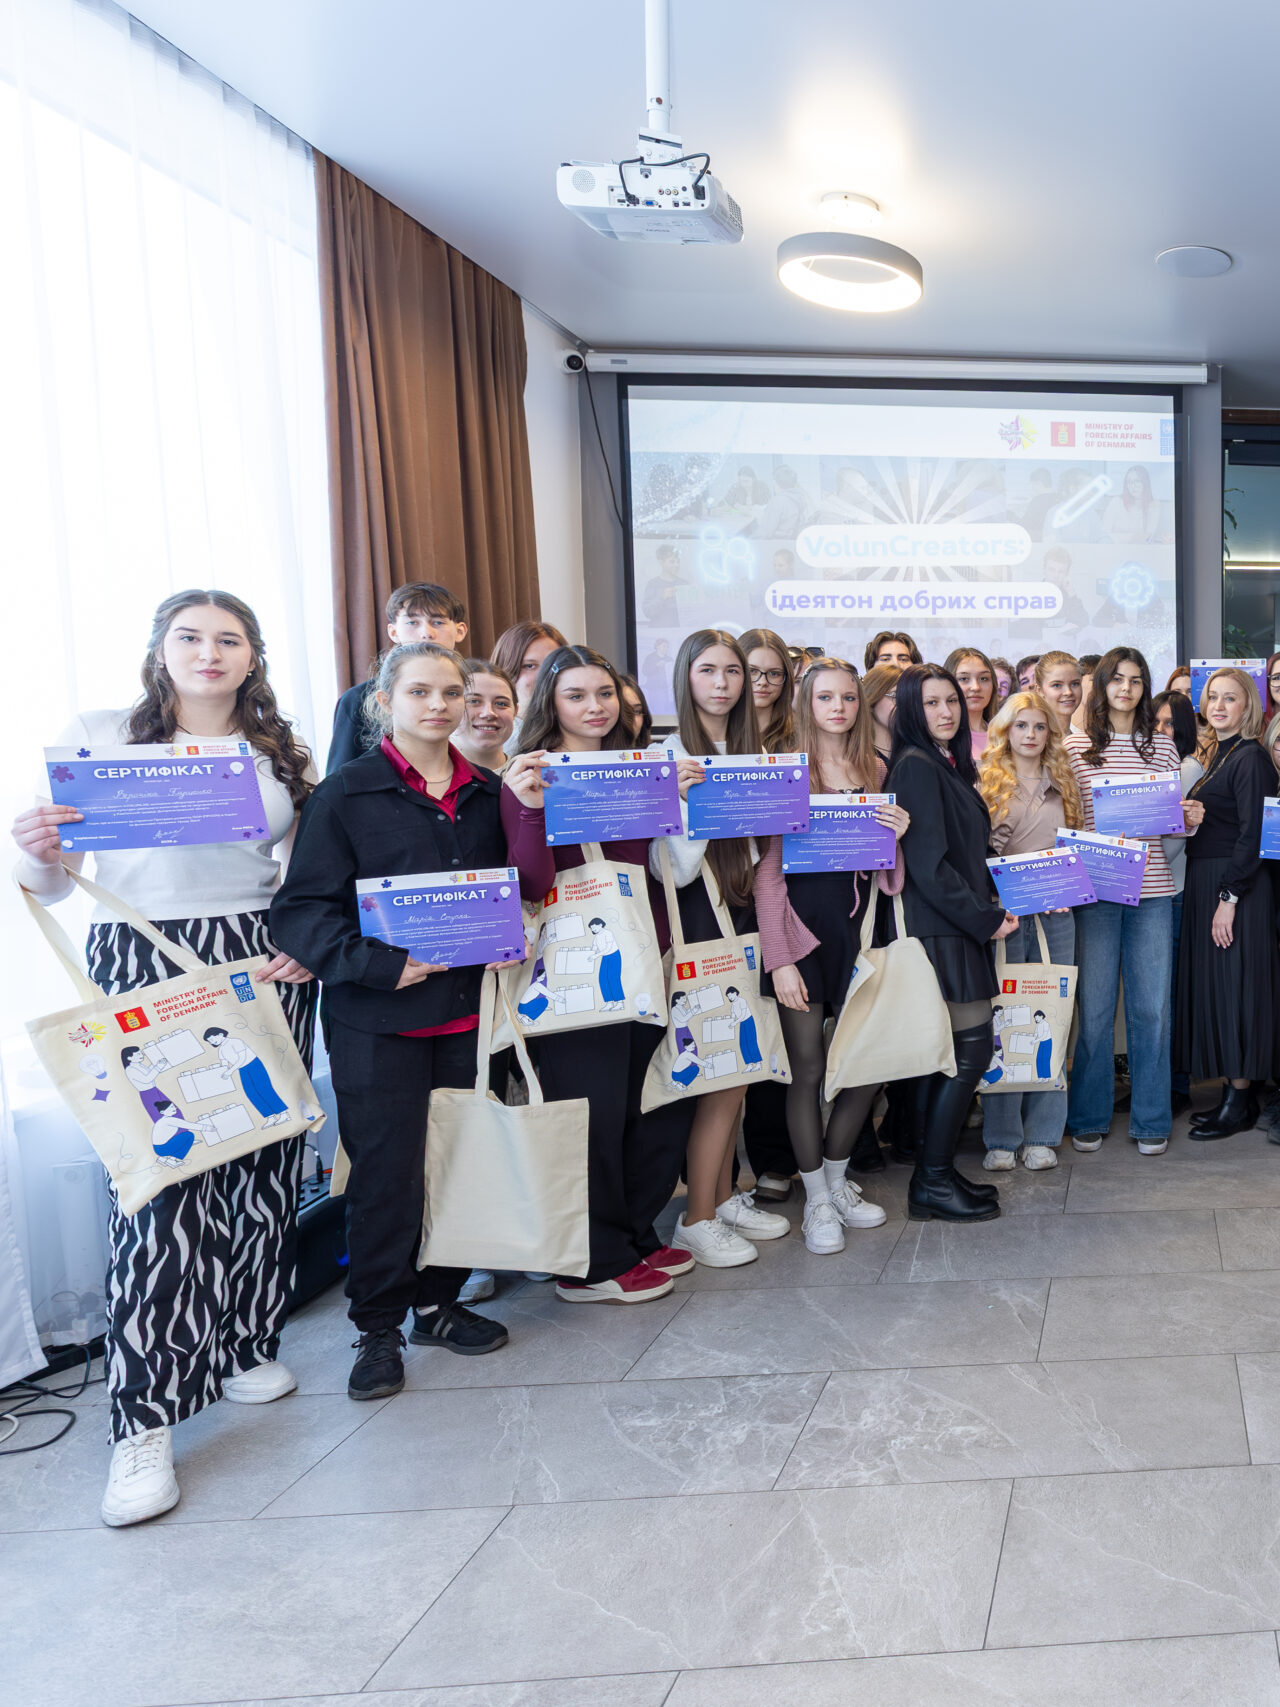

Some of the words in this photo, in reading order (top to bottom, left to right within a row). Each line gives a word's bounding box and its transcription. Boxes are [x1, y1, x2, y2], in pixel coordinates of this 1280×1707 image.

[1120, 432, 1153, 440] AFFAIRS
[804, 535, 1026, 558] VolunCreators:
[771, 590, 873, 611] ідеятон
[880, 590, 976, 615] добрих
[984, 594, 1057, 615] справ
[93, 764, 215, 779] СЕРТИФІКАТ
[571, 768, 651, 780] СЕРТИФІКАТ
[712, 771, 785, 782] СЕРТИФІКАТ
[1110, 785, 1163, 797] СЕРТИФІКАТ
[1009, 858, 1064, 873] СЕРТИФІКАТ
[565, 881, 589, 889] MINISTRY
[392, 889, 488, 906] СЕРТИФІКАТ
[702, 955, 727, 964] MINISTRY
[702, 962, 725, 970] FOREIGN
[712, 965, 736, 974] DENMARK
[153, 990, 195, 1008] MINISTRY
[197, 986, 207, 994] OF
[156, 998, 195, 1015] FOREIGN
[196, 988, 229, 1002] AFFAIRS
[160, 1014, 171, 1022] OF
[173, 1000, 217, 1018] DENMARK
